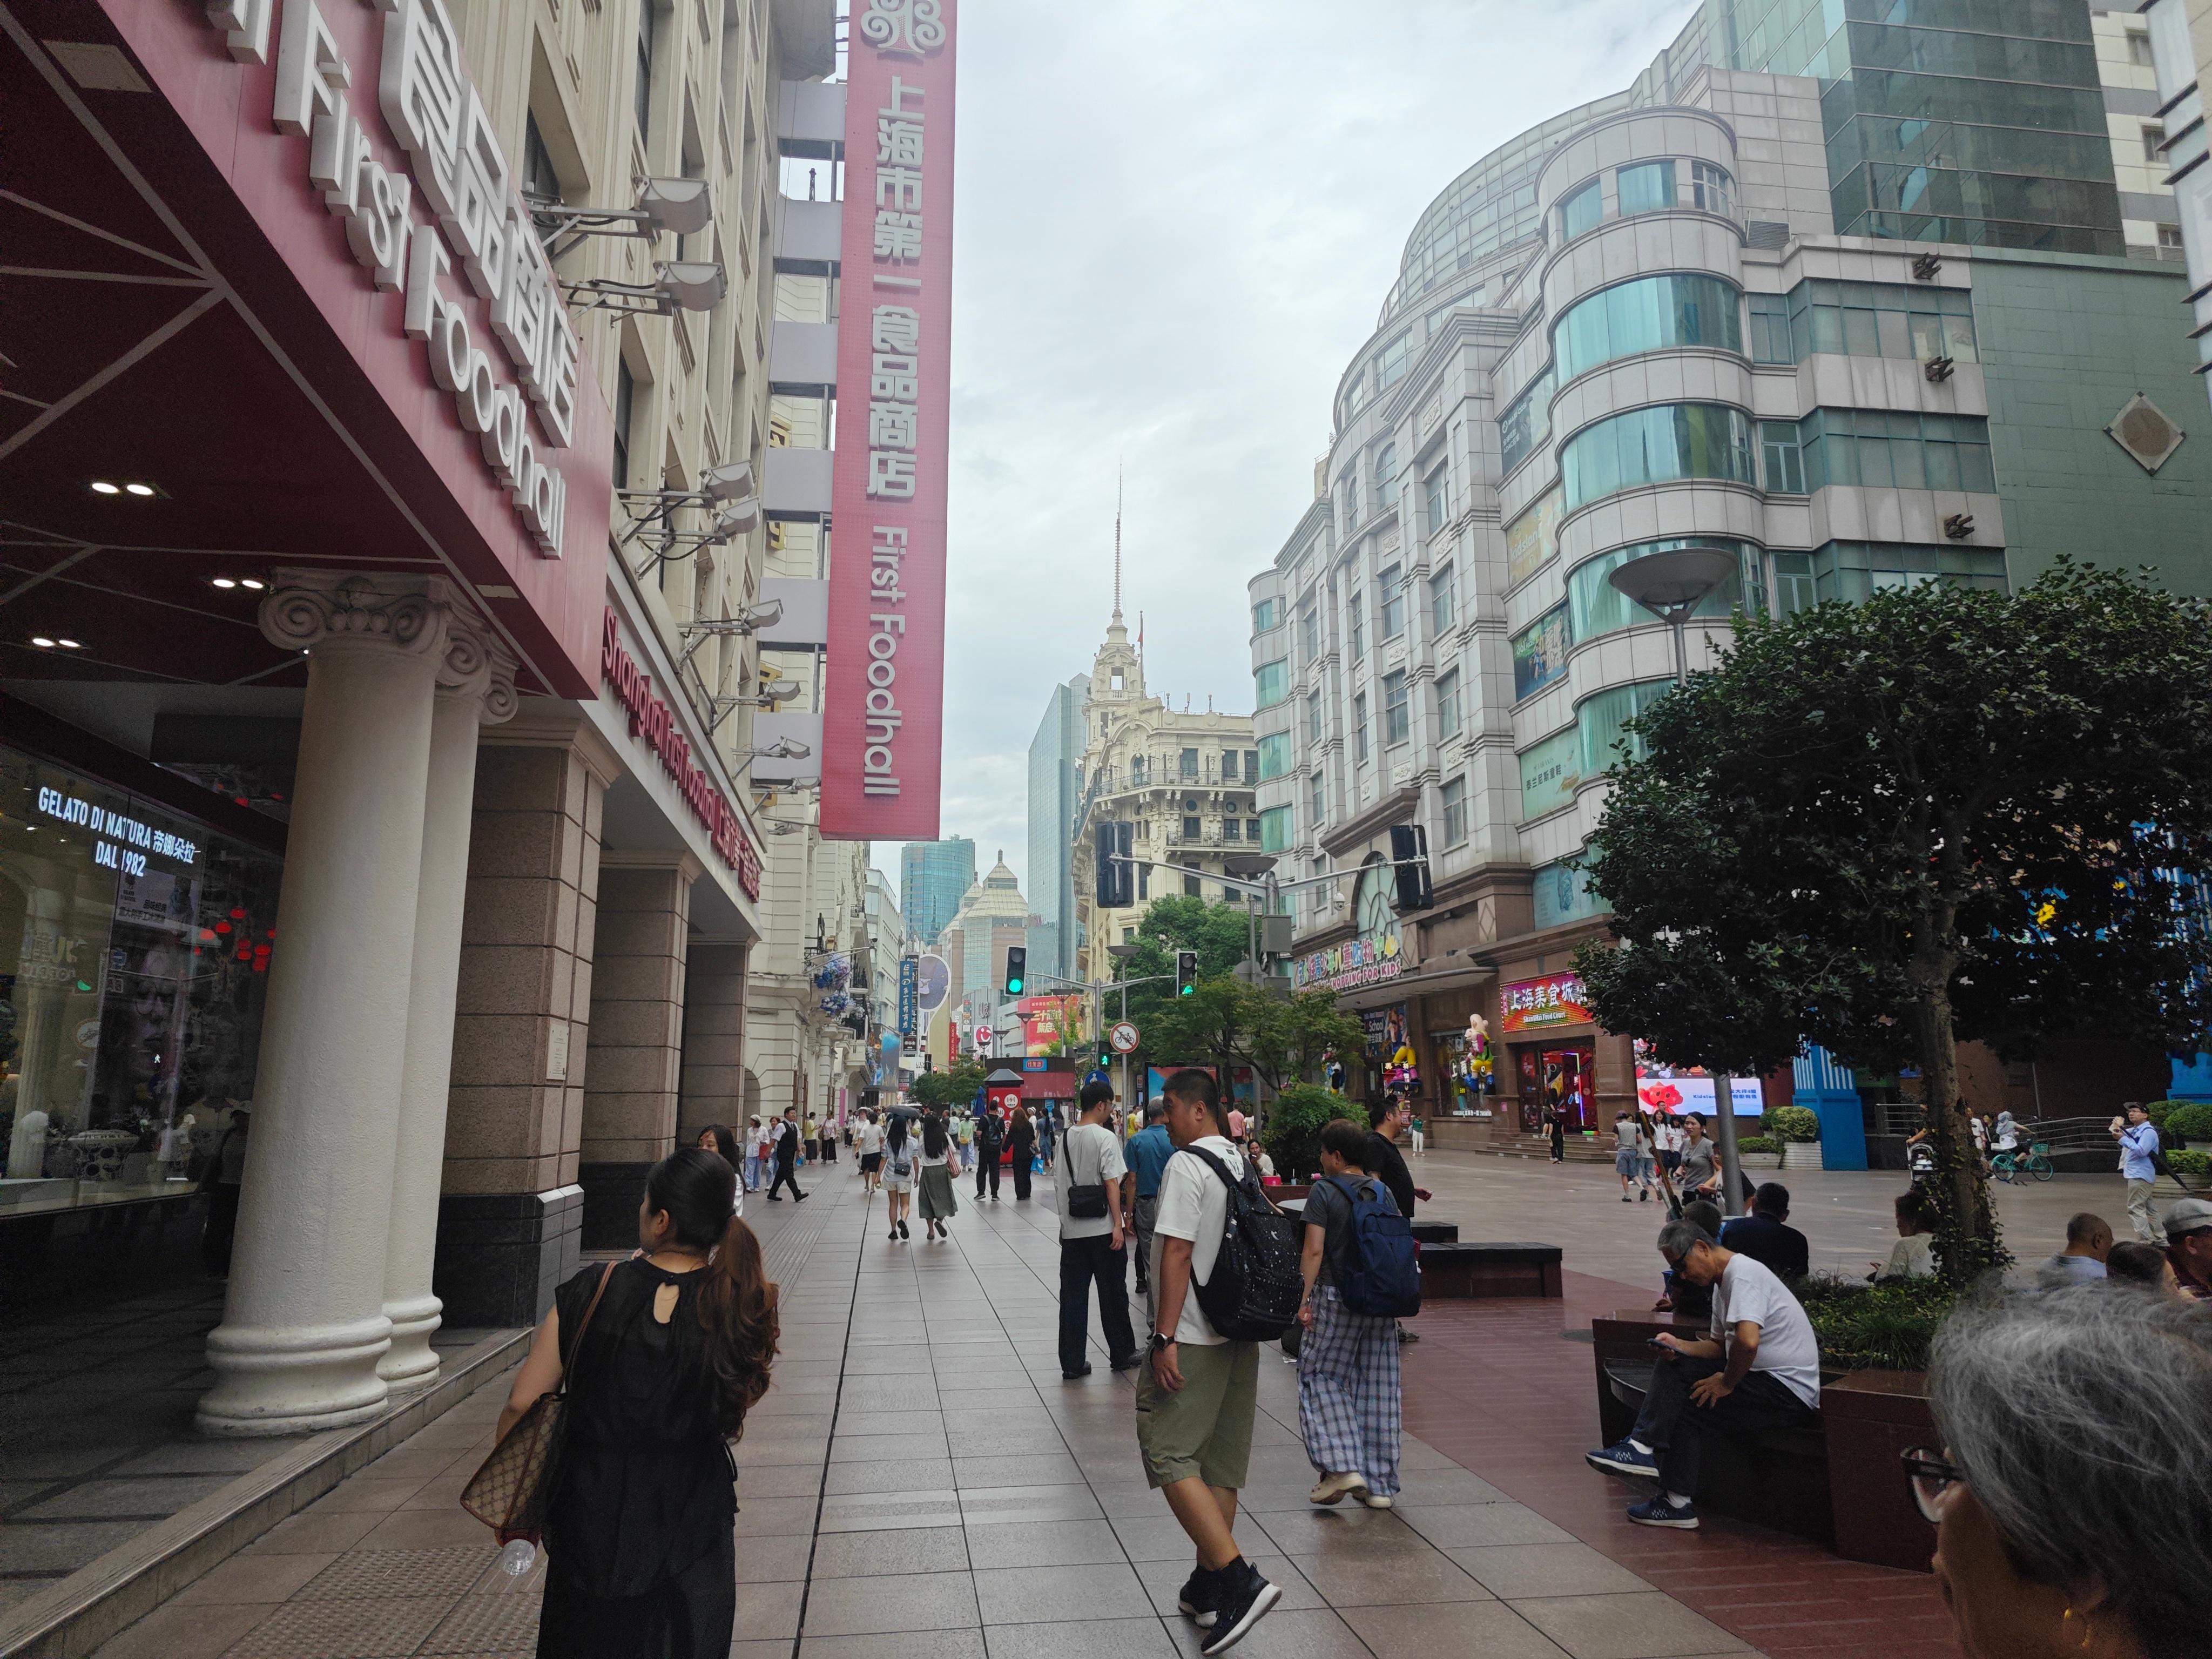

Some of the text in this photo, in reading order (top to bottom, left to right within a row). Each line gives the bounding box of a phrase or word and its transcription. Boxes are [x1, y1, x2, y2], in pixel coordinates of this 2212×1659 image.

[273, 0, 565, 560] First Foodhall
[373, 0, 577, 448] 食品商店
[866, 75, 925, 497] 上海市第一食品商店
[602, 605, 716, 831] Shanghai First Foodhall
[864, 525, 908, 795] First Foodhall
[38, 786, 195, 864] GELATO DI NATURA 帝娜朵拉
[96, 840, 146, 877] DAL 1982
[1363, 966, 1379, 982] FOR
[1380, 959, 1401, 977] KIDS
[1369, 1019, 1384, 1032] School
